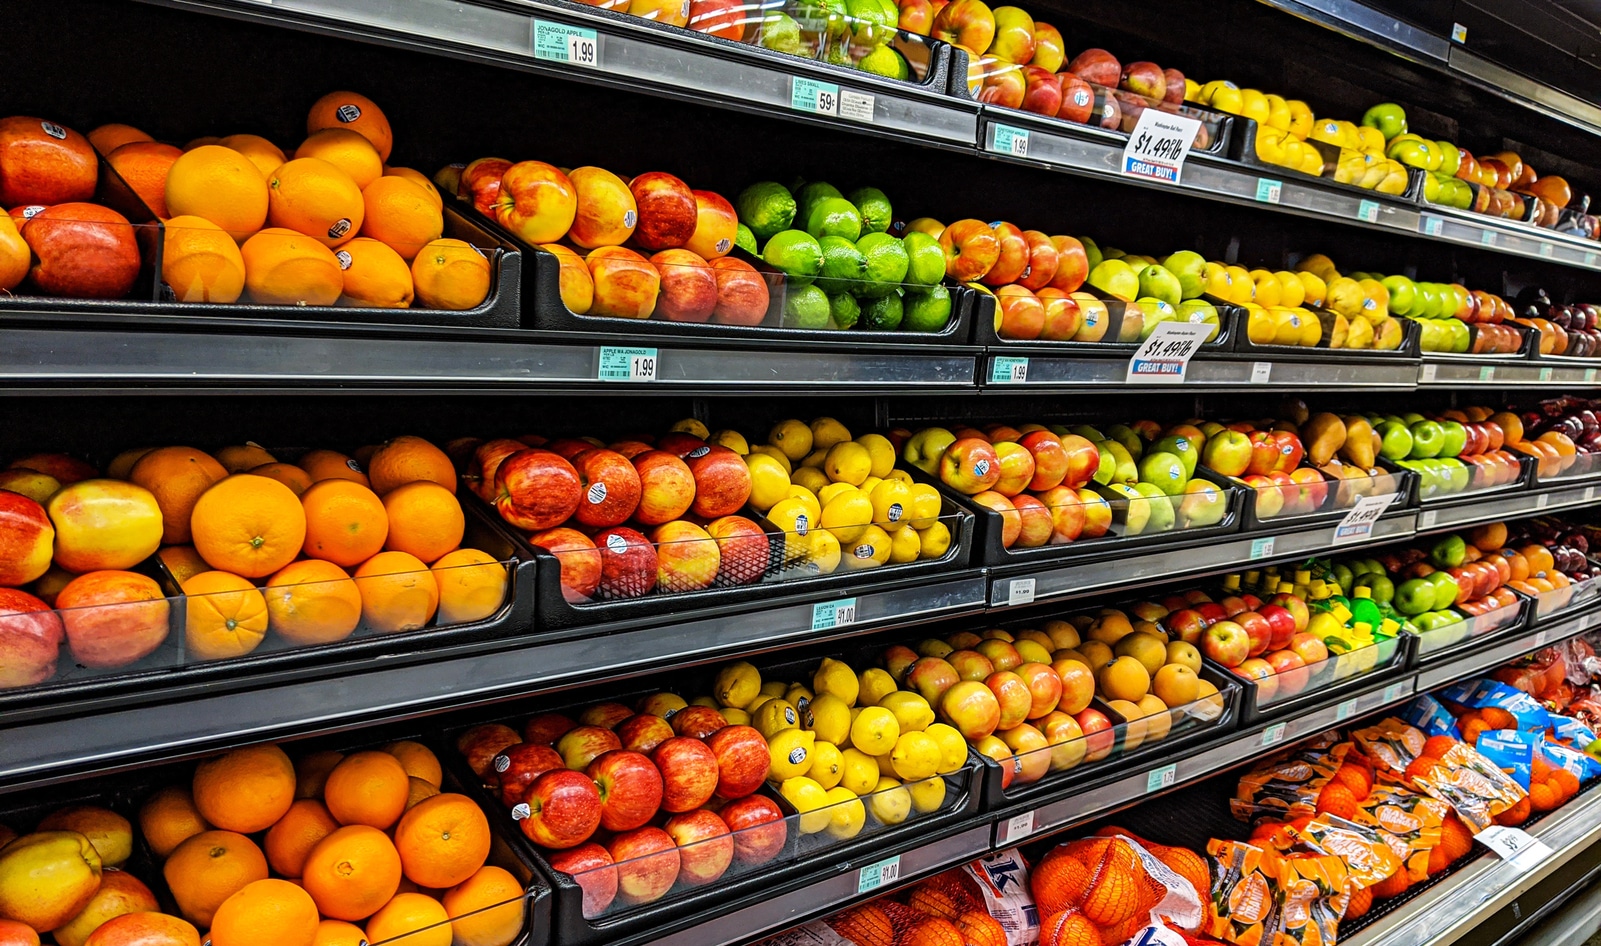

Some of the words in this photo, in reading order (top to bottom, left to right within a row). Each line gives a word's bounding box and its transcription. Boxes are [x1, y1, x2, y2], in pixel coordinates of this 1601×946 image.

[537, 25, 566, 35] JONAGOLD
[573, 40, 594, 62] 1.99
[819, 92, 835, 110] 59¢
[1014, 138, 1026, 154] 1.99
[1135, 131, 1171, 157] $1.49
[1131, 161, 1155, 176] GREAT
[1155, 166, 1173, 179] BUY!
[1144, 339, 1181, 356] $1.49
[635, 358, 654, 376] 1.99
[1014, 366, 1026, 379] 1.99
[1137, 362, 1161, 372] GREAT
[1161, 363, 1179, 372] BUY!
